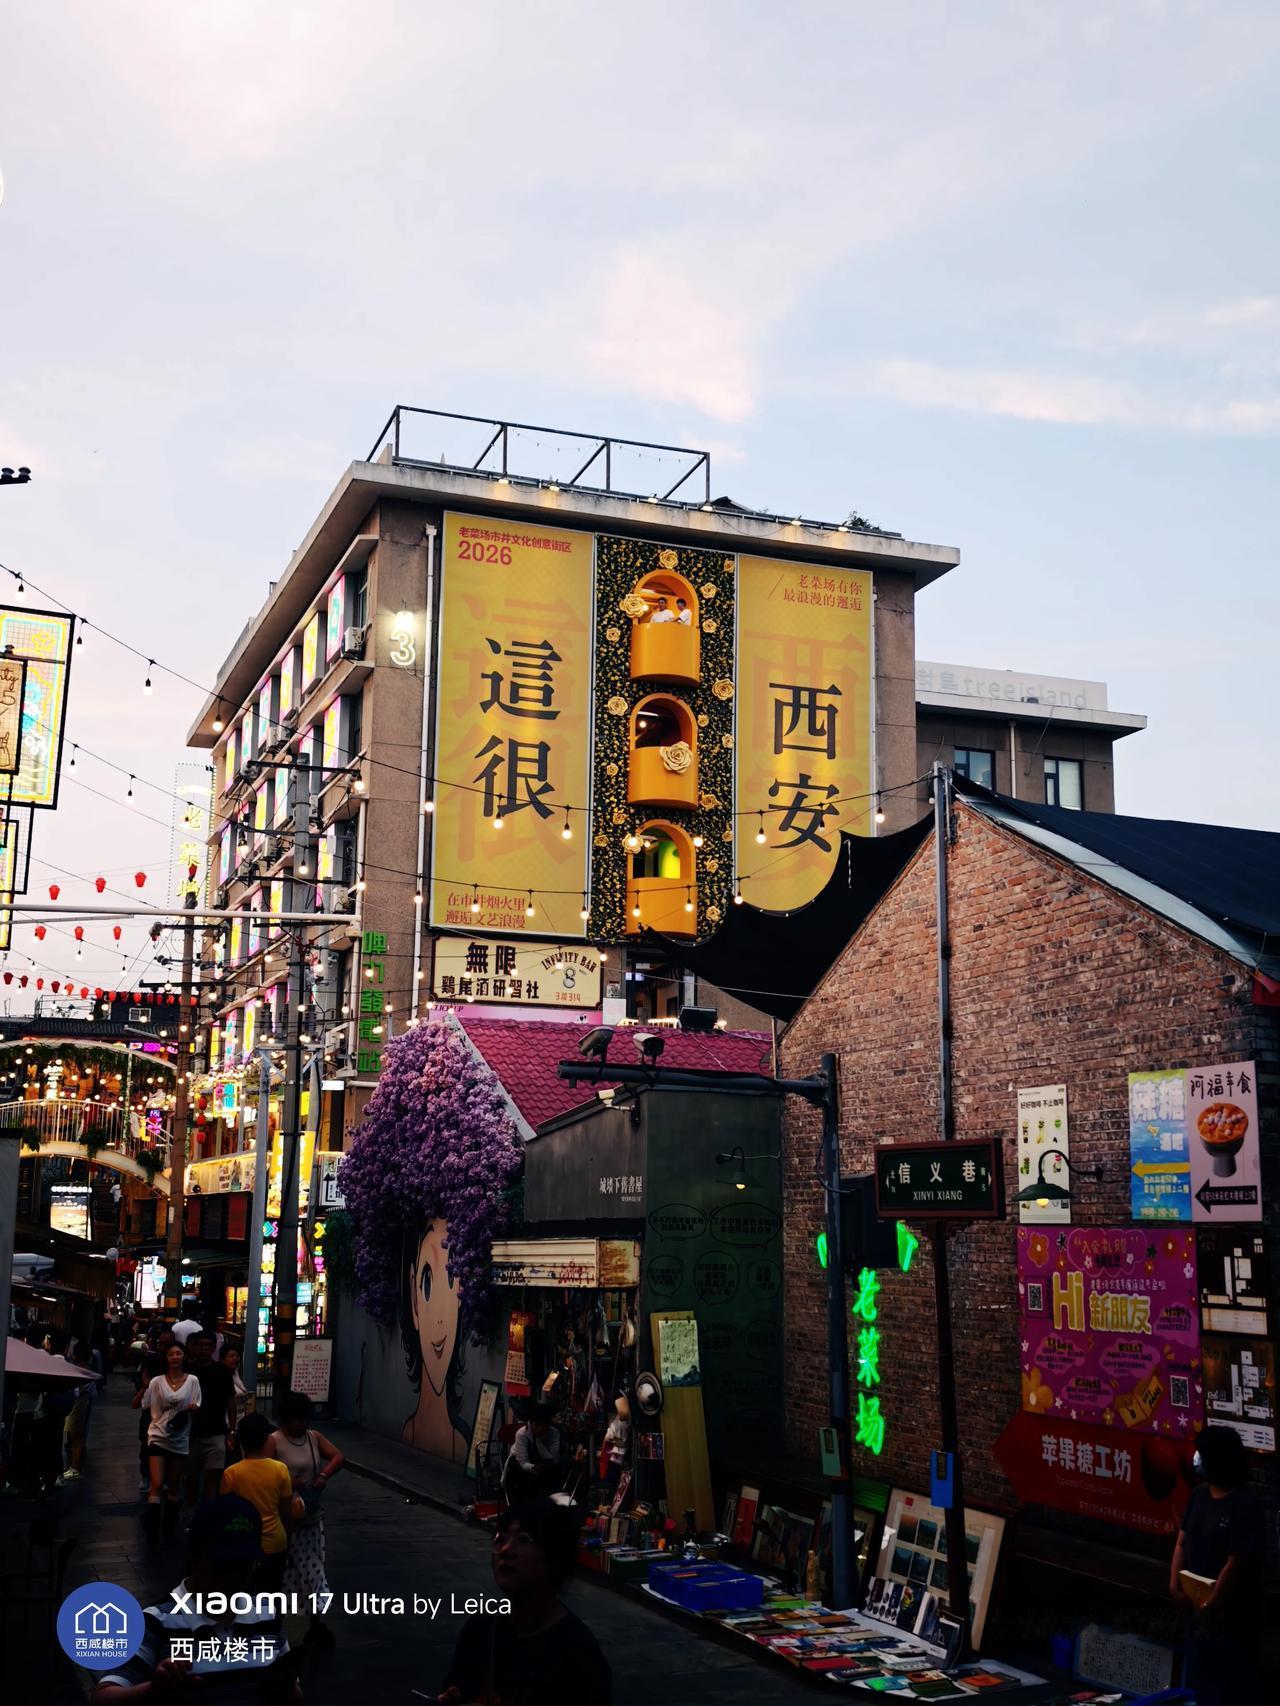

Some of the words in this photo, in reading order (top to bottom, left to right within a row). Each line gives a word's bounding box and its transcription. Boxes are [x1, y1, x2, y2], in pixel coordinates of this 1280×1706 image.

[458, 526, 573, 553] 老菜场市井文化创意街区
[458, 540, 513, 566] 2026
[798, 574, 863, 595] 老菜场有你
[783, 588, 862, 611] 最浪漫的邂逅
[390, 631, 416, 666] 3
[472, 637, 563, 821] 這很
[768, 682, 843, 853] 西安
[447, 893, 526, 911] 在市井烟火里
[445, 909, 526, 928] 邂逅文艺浪漫
[466, 941, 517, 976] 無限
[541, 951, 580, 971] INFINITY
[580, 955, 598, 973] BAR
[898, 1160, 976, 1184] 信义巷
[913, 1190, 934, 1201] XINYI
[937, 1190, 963, 1200] XIANG
[1052, 1270, 1087, 1333] Hi
[1089, 1290, 1152, 1334] 新朋友
[1040, 1433, 1133, 1484] 苹果糖工坊
